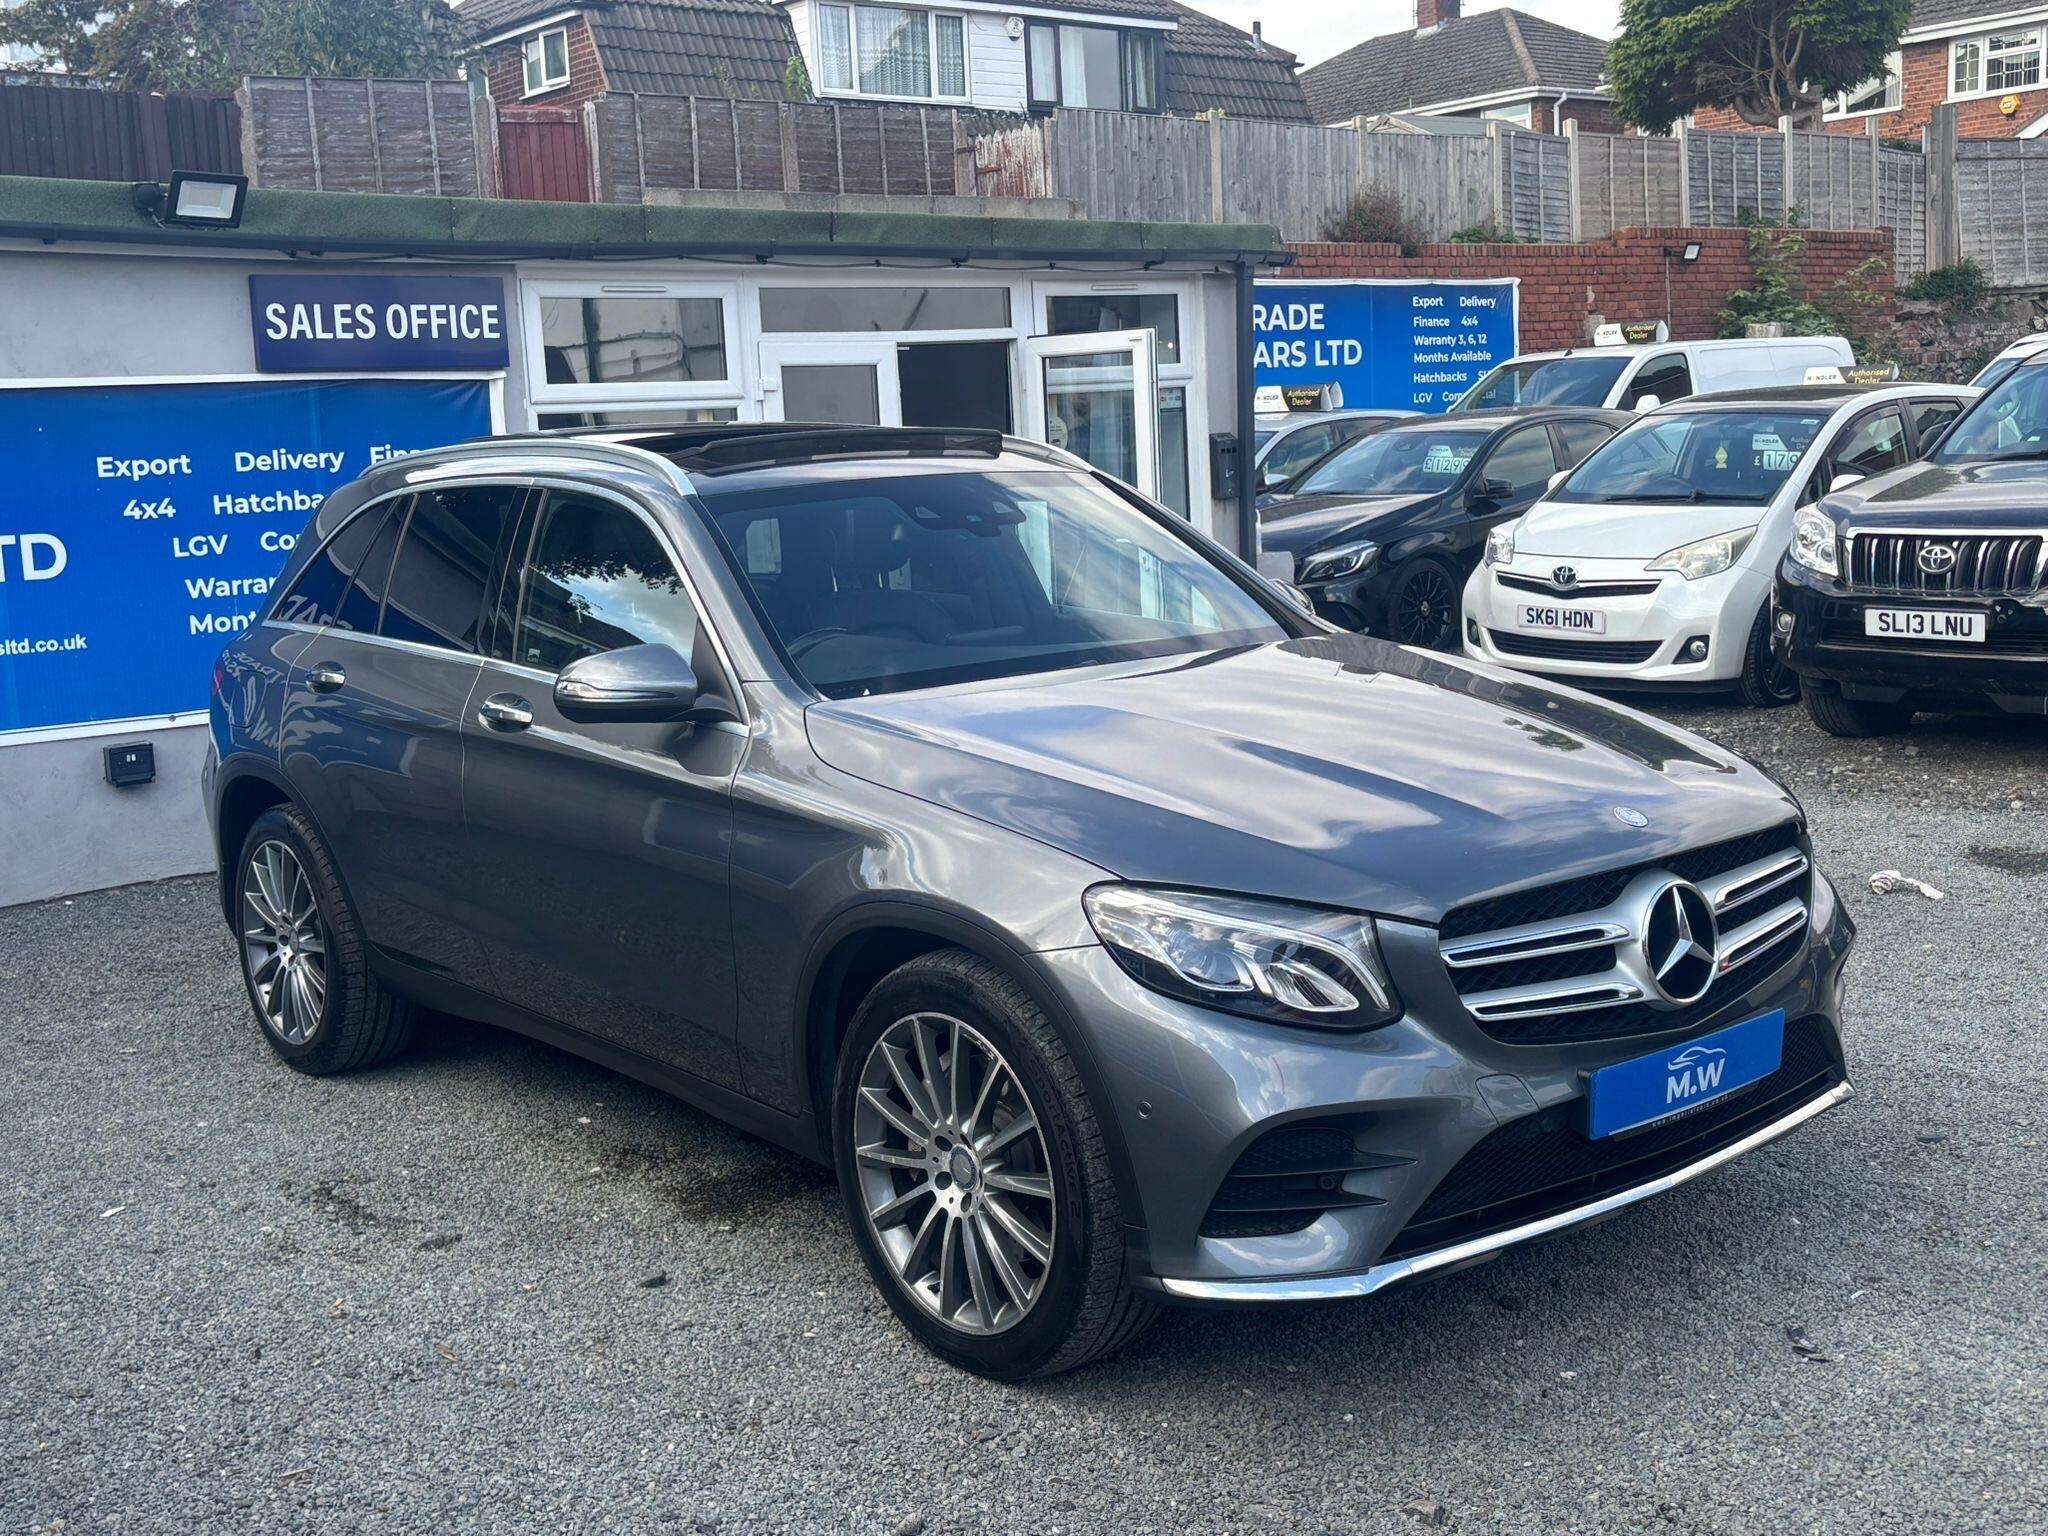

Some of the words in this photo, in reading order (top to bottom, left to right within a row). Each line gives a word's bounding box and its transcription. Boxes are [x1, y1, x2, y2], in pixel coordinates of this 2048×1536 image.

[1412, 296, 1444, 309] Export
[1459, 296, 1497, 309] Delivery
[265, 303, 377, 340] SALES
[385, 304, 501, 339] OFFICE
[1413, 316, 1450, 327] Finance
[1461, 316, 1478, 326] 4x4
[1413, 334, 1457, 347] Warranty
[1458, 334, 1467, 346] 3,
[1468, 334, 1477, 346] 6,
[1478, 333, 1487, 344] 12
[1314, 339, 1362, 366] LTD
[1413, 352, 1449, 363] Months
[1450, 351, 1492, 362] Available
[1413, 371, 1467, 383] Hatchbacks
[1847, 367, 1890, 377] Authorised
[1413, 392, 1433, 404] LGV
[96, 454, 193, 482] Export
[234, 448, 345, 474] Delivery
[123, 497, 177, 520] 4x4
[172, 534, 229, 558] LGV
[0, 533, 68, 583] TD
[1526, 607, 1559, 626] SK61
[1562, 610, 1594, 629] HDN
[1878, 612, 1925, 634] SL13
[1930, 614, 1973, 637] LNU
[1666, 1058, 1726, 1104] M.W
